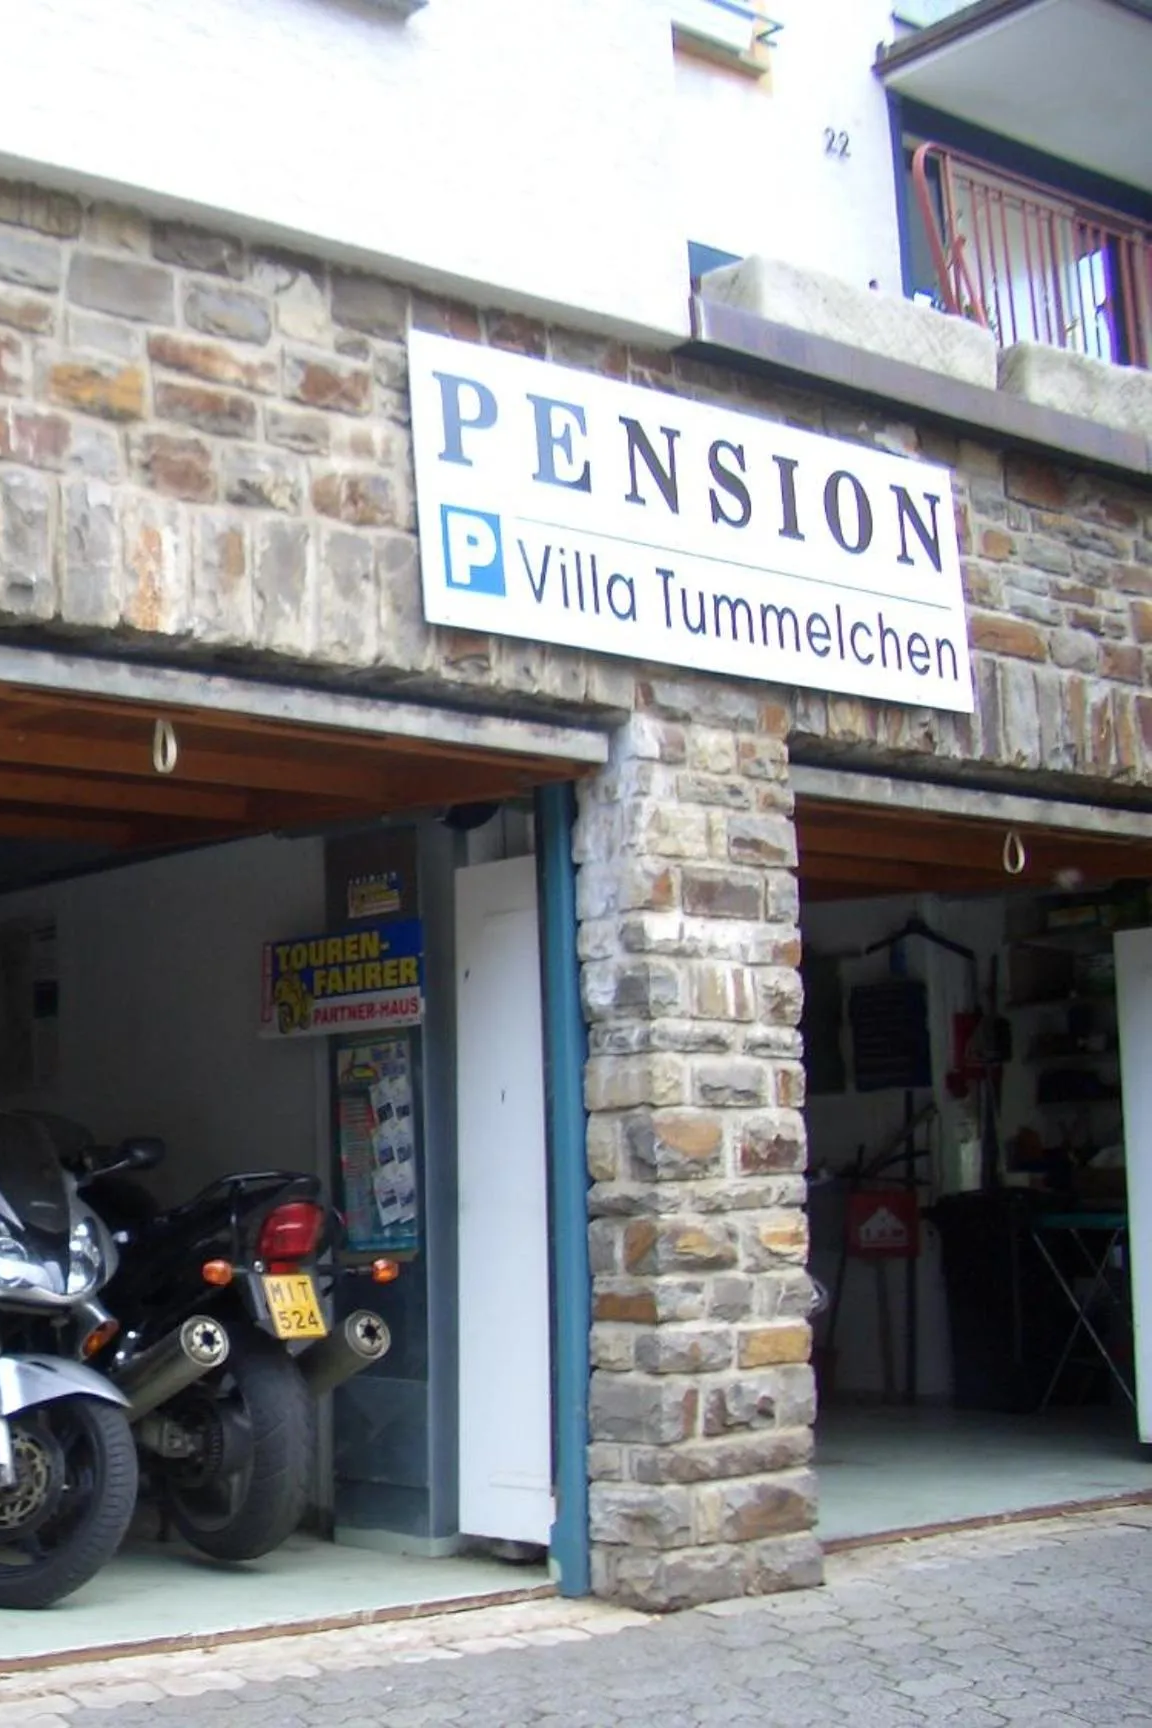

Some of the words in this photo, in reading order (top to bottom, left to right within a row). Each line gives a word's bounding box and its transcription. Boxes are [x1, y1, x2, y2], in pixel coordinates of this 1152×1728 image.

[824, 127, 851, 157] 22
[432, 371, 942, 574] PENSION
[446, 510, 501, 588] P
[517, 539, 637, 622] Villa
[655, 567, 958, 681] Tummelchen
[275, 930, 390, 971] TOUREN-
[313, 956, 418, 996] FAHRER
[313, 997, 419, 1024] PARTNER-HAUS
[278, 1309, 320, 1330] 524
